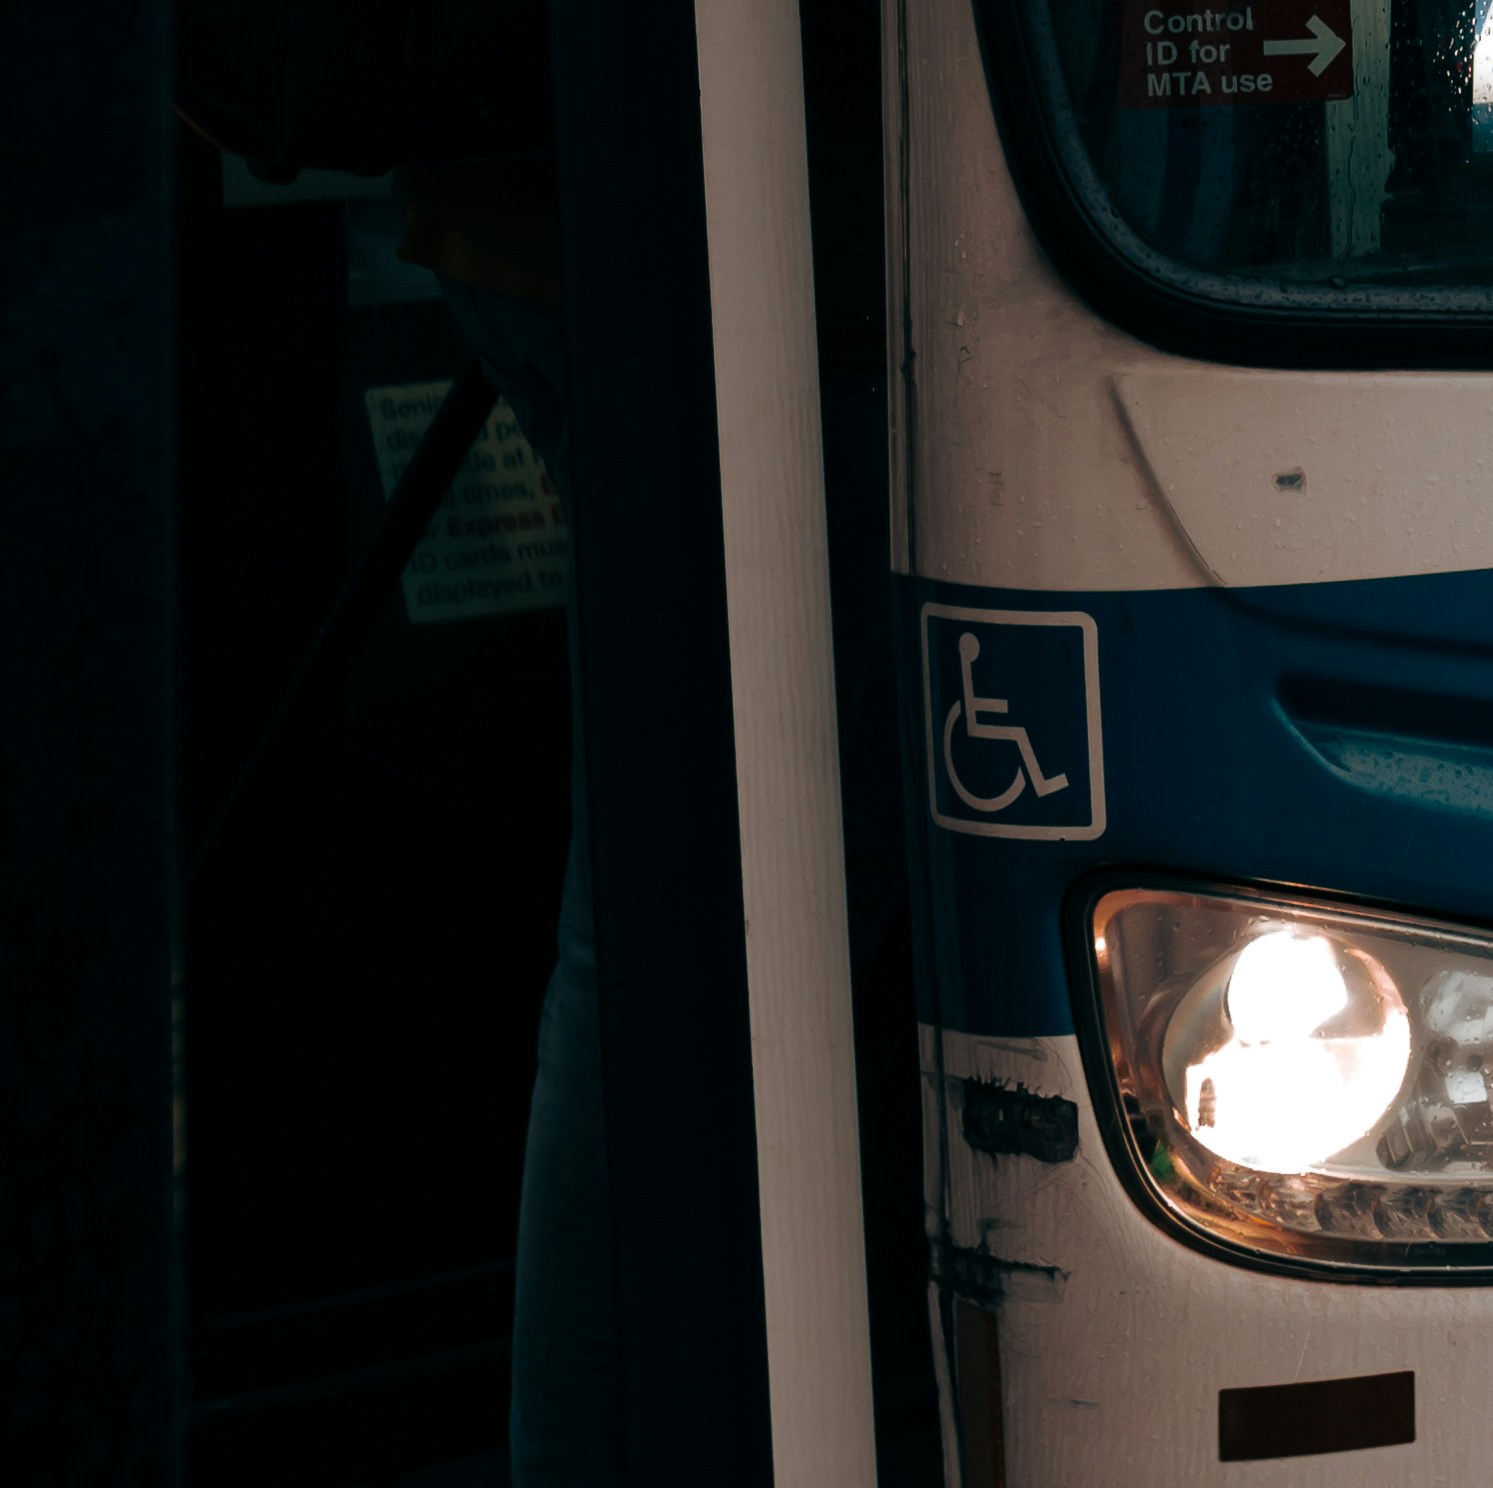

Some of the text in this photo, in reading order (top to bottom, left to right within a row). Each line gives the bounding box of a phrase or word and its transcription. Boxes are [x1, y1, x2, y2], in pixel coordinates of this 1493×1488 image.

[1144, 6, 1254, 35] Control
[1146, 40, 1230, 66] ID for
[1147, 71, 1274, 97] MTA use
